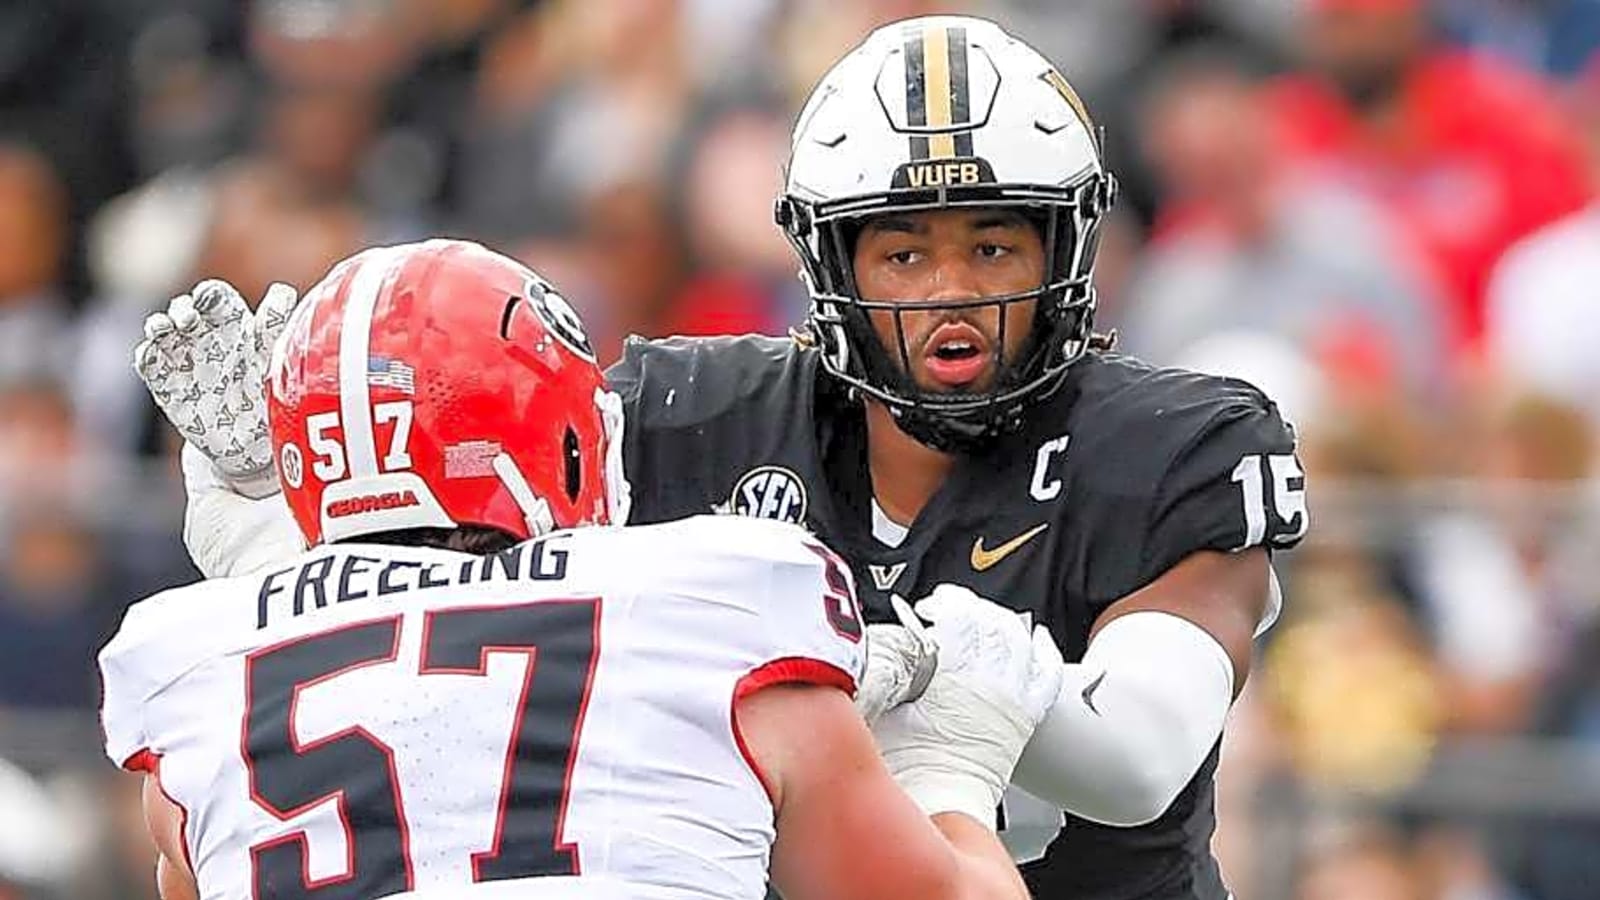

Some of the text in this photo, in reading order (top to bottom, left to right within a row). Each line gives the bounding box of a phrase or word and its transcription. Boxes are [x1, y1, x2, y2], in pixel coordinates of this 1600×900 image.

[907, 163, 980, 187] VUFB
[306, 401, 414, 482] 57
[1029, 434, 1070, 501] C
[326, 490, 420, 518] GEORGIA
[738, 471, 801, 524] SEC
[1230, 453, 1309, 548] 15
[256, 533, 573, 630] FREELING
[868, 562, 908, 591] V
[240, 596, 603, 900] 57
